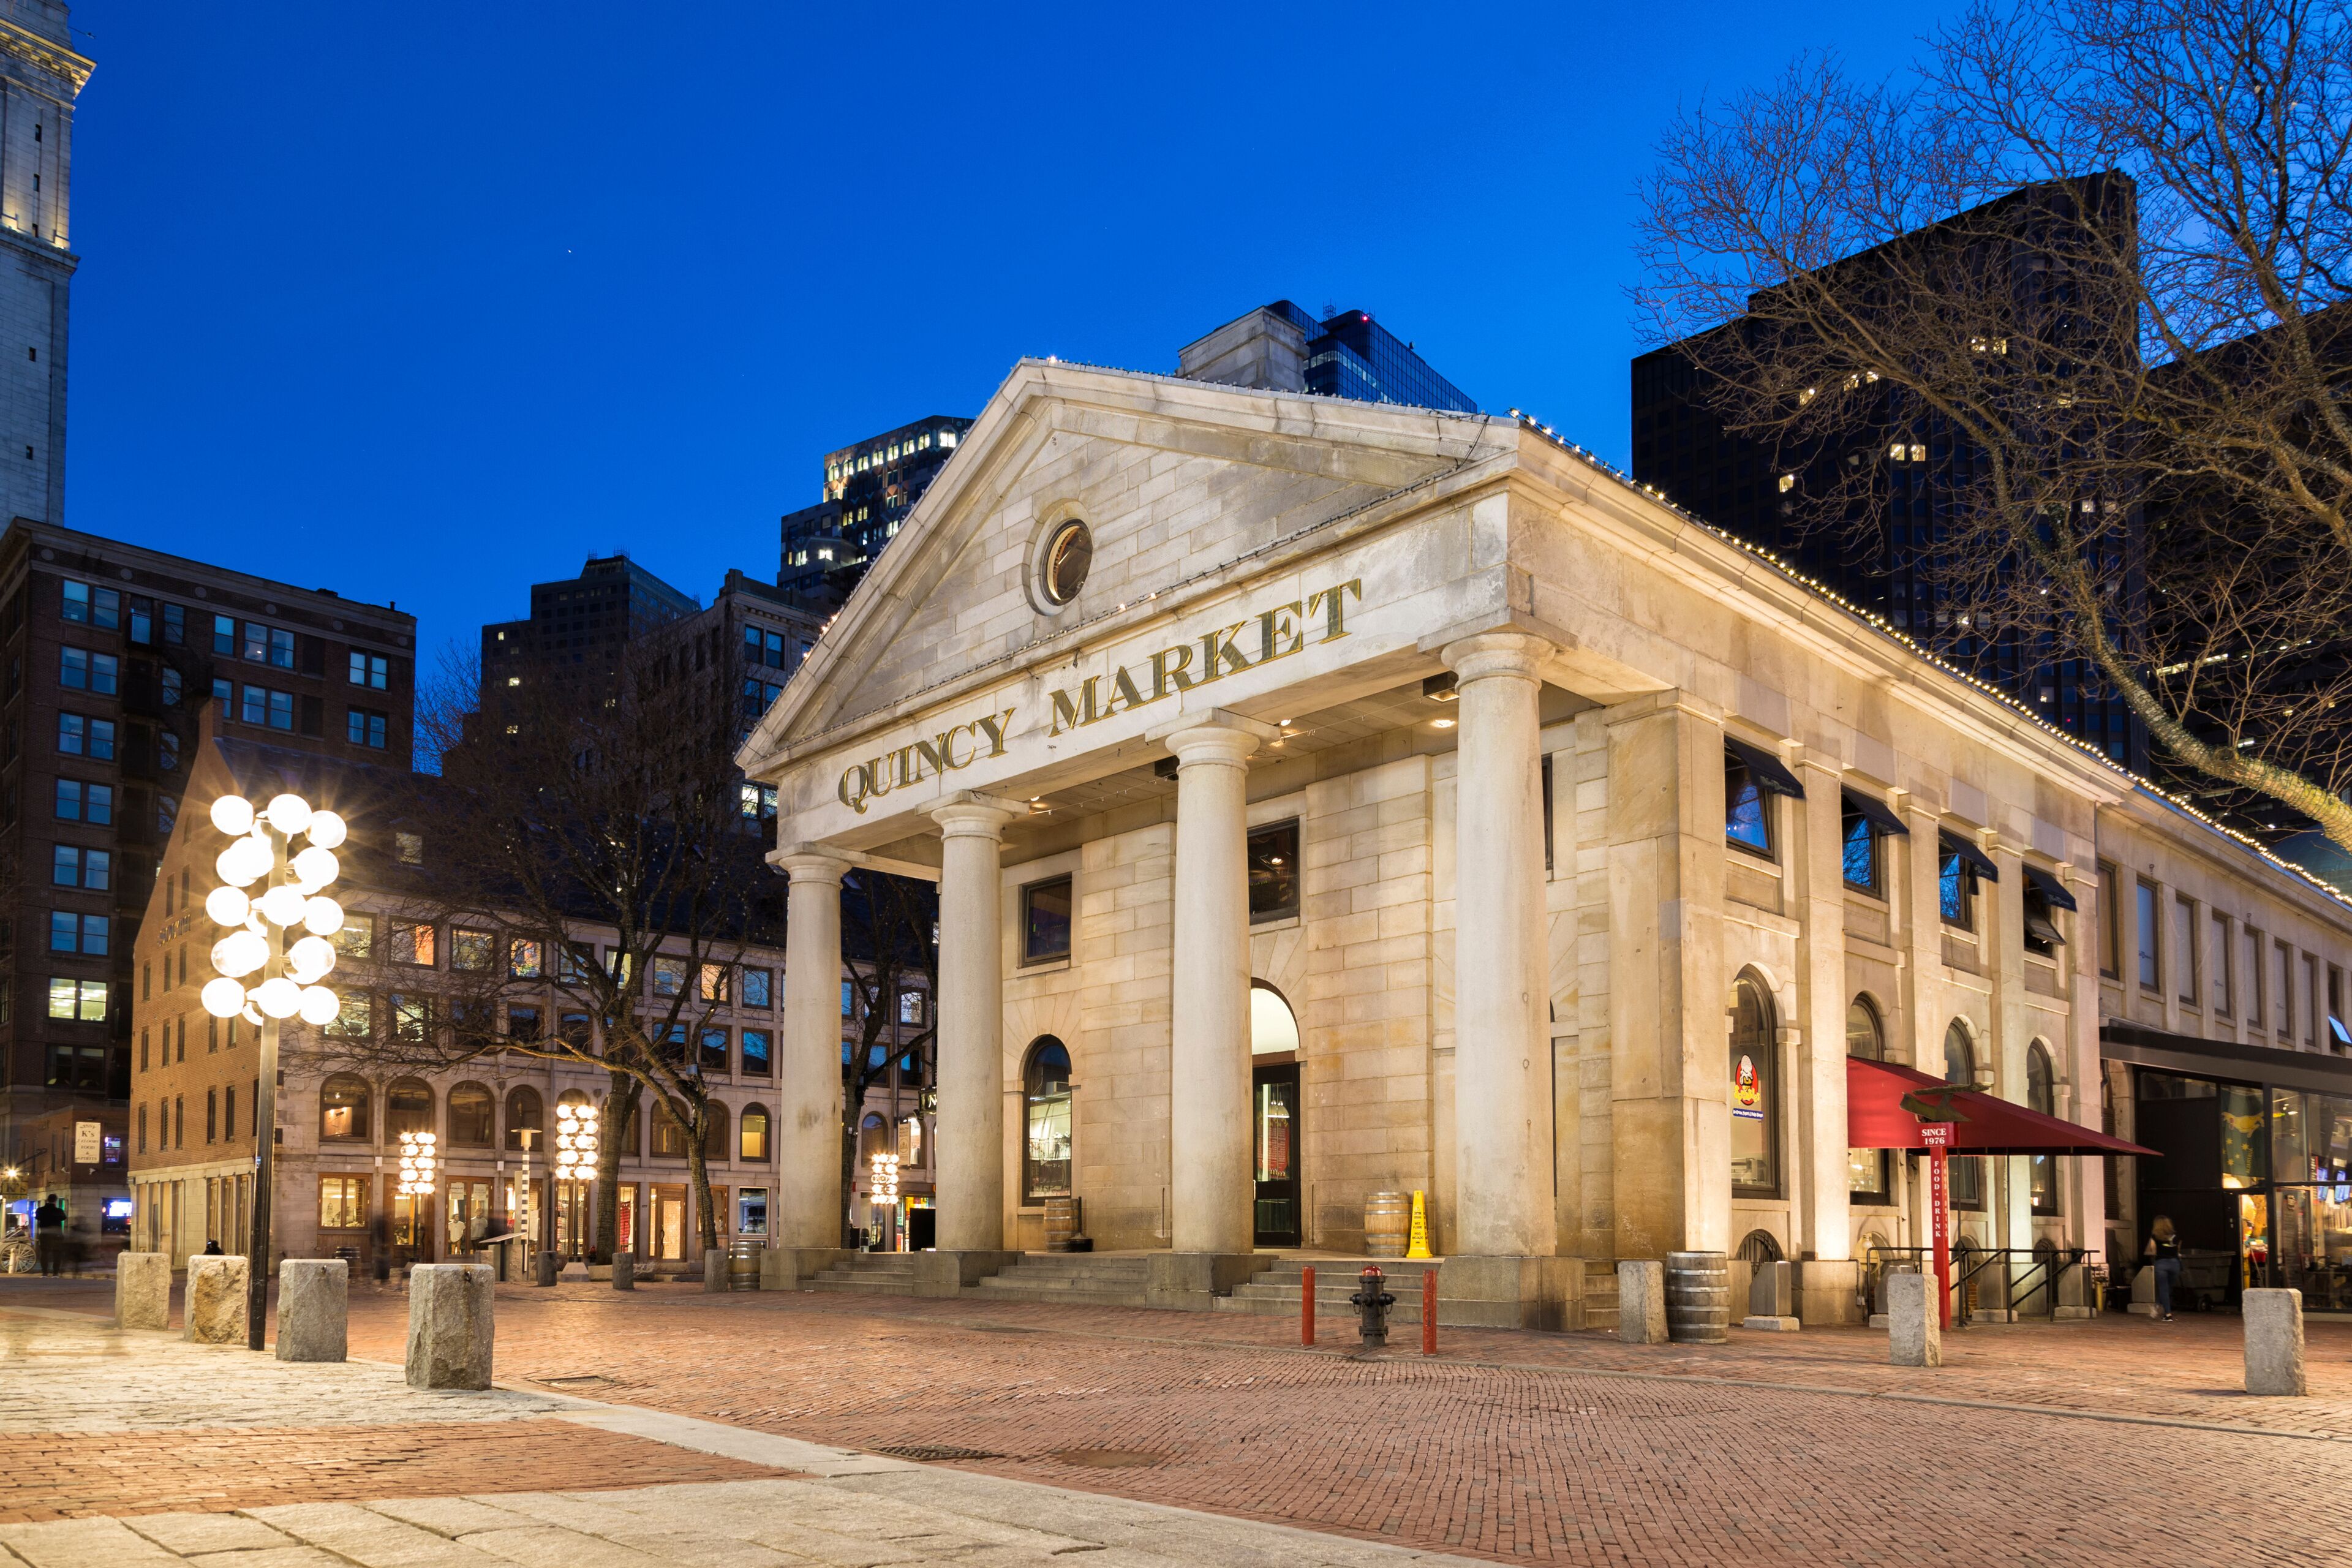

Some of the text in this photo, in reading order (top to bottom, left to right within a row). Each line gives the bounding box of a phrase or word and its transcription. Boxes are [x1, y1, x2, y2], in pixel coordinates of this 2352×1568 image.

[838, 578, 1362, 815] QUINCY MARKET
[1921, 1128, 1947, 1137] SINCE
[1924, 1137, 1945, 1145] 1976
